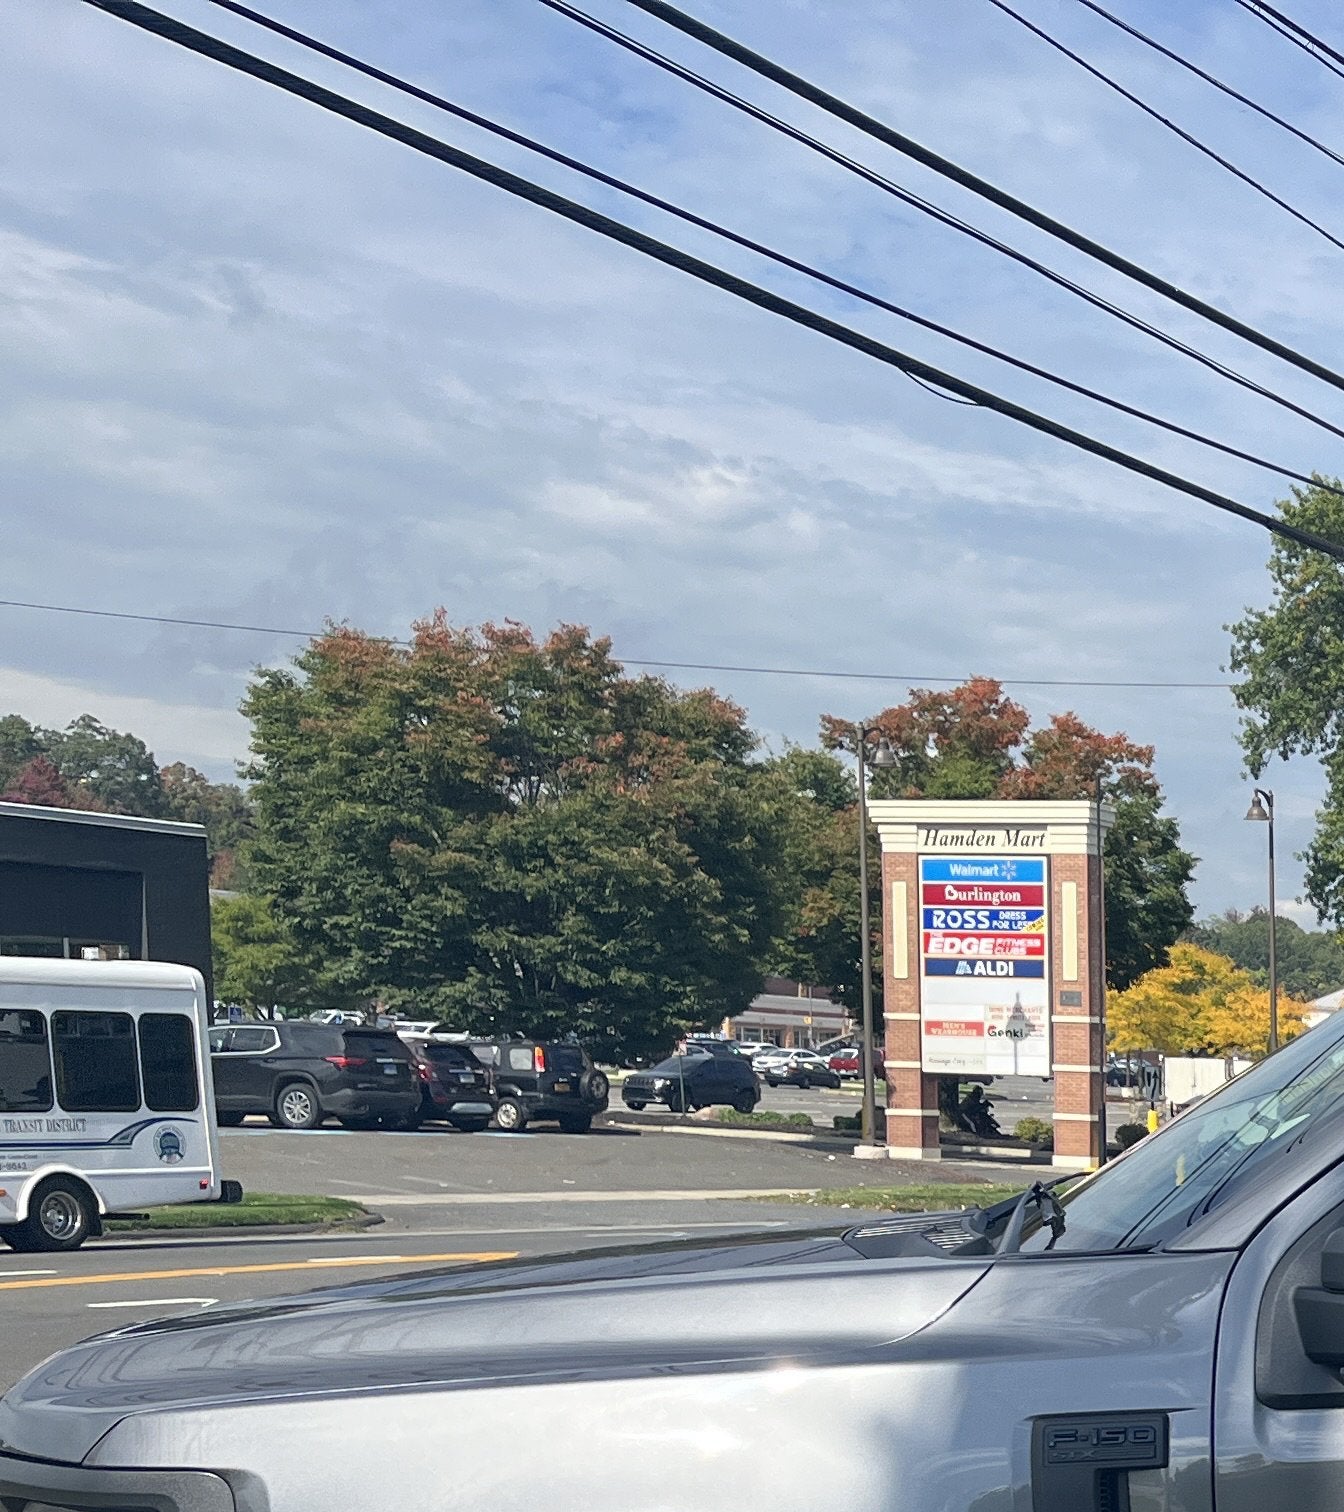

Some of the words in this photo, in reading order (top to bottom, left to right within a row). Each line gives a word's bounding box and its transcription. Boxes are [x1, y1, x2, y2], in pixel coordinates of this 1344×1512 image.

[923, 829, 996, 847] Hamden
[1001, 829, 1045, 847] Mart
[949, 863, 999, 877] Walmart
[944, 884, 1021, 905] Burlington
[932, 910, 990, 928] ROSS
[998, 911, 1027, 920] DRESS
[992, 920, 1009, 929] FOR
[928, 936, 995, 954] EDGE
[973, 961, 1014, 976] ALDI
[4, 1119, 43, 1133] TRANSIT
[46, 1118, 87, 1132] DISTRICT
[1048, 1426, 1157, 1448] F-150
